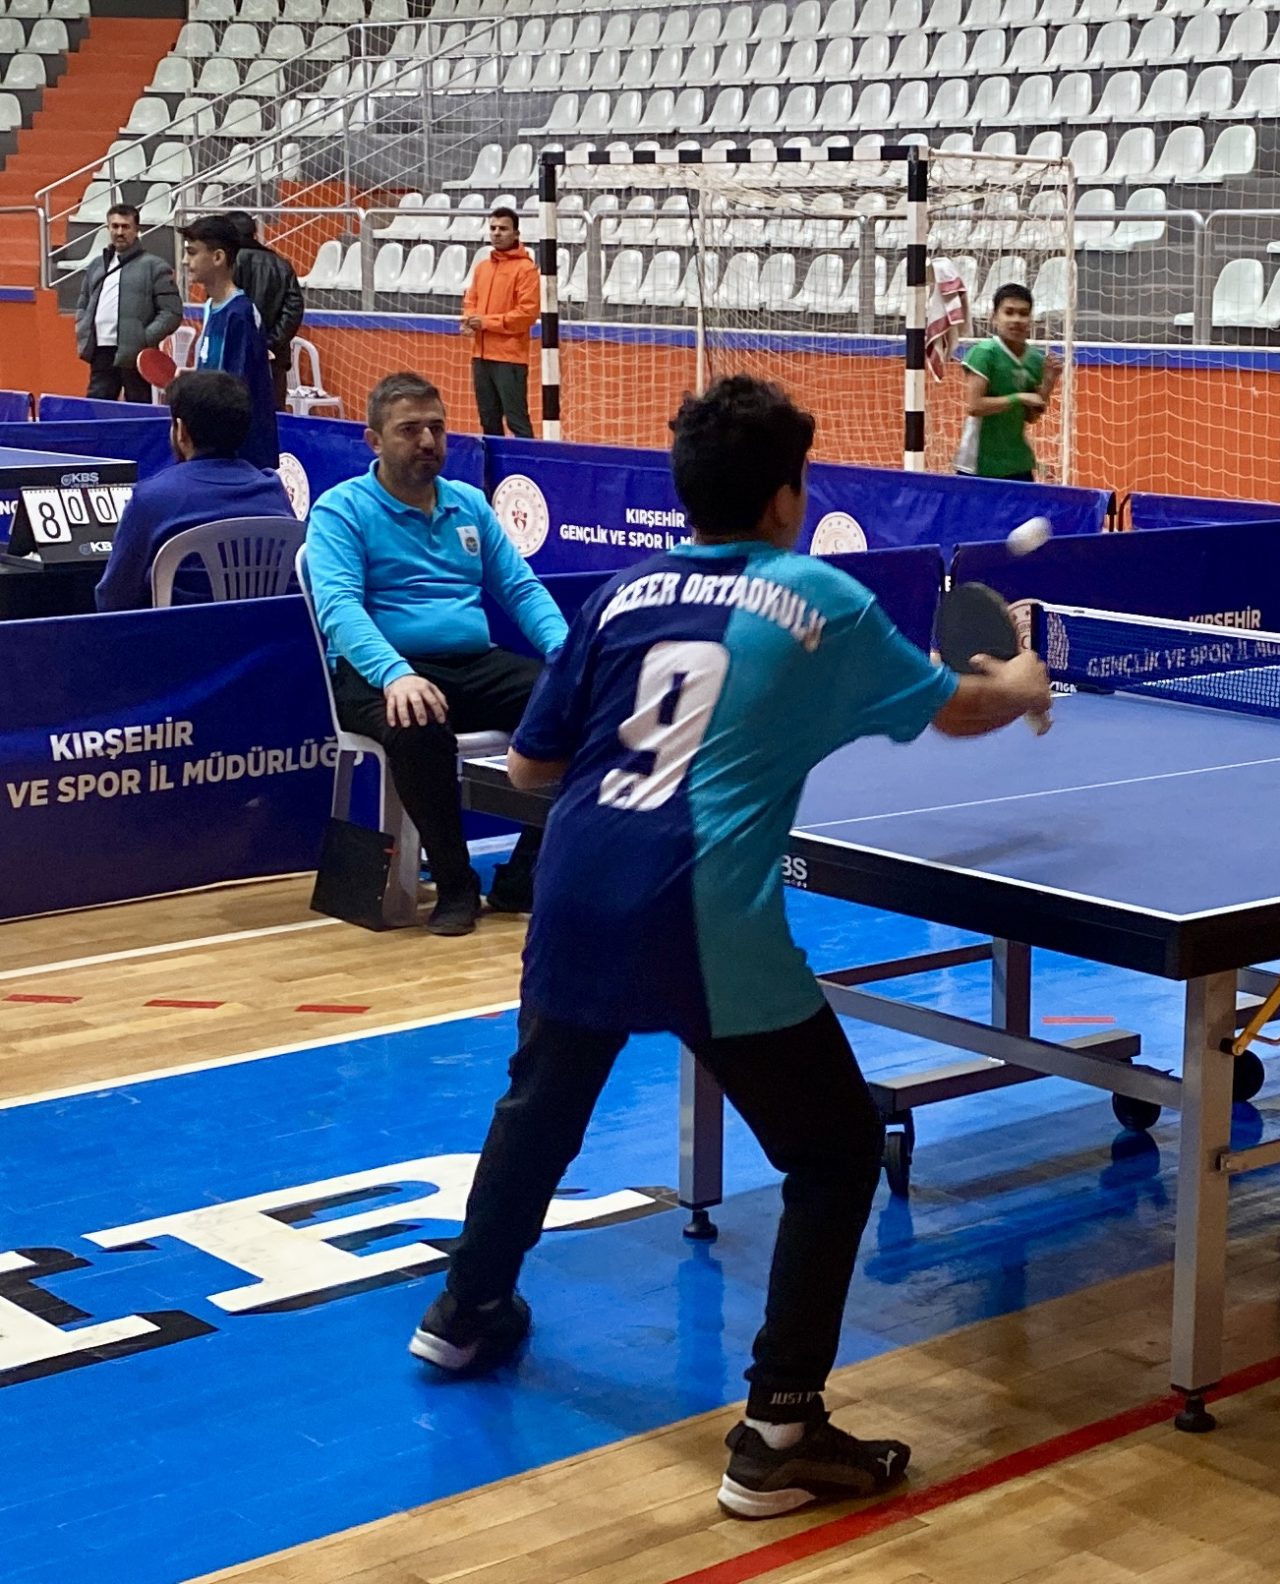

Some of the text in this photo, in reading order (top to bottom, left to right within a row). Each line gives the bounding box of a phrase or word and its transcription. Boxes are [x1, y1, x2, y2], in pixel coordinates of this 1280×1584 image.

[72, 472, 99, 484] KBS
[39, 502, 61, 538] 8
[69, 496, 83, 521] 0
[96, 496, 112, 521] 0
[626, 507, 686, 528] KIRŞEHİR
[90, 541, 113, 553] KB
[559, 524, 608, 544] GENÇLİK
[610, 529, 626, 546] VE
[628, 532, 663, 549] SPOR
[597, 640, 731, 812] 9
[50, 717, 194, 761] KIRŞEHİR
[7, 736, 364, 808] VE SPOR İL MÜDÜRLÜĞ
[782, 855, 808, 880] BS
